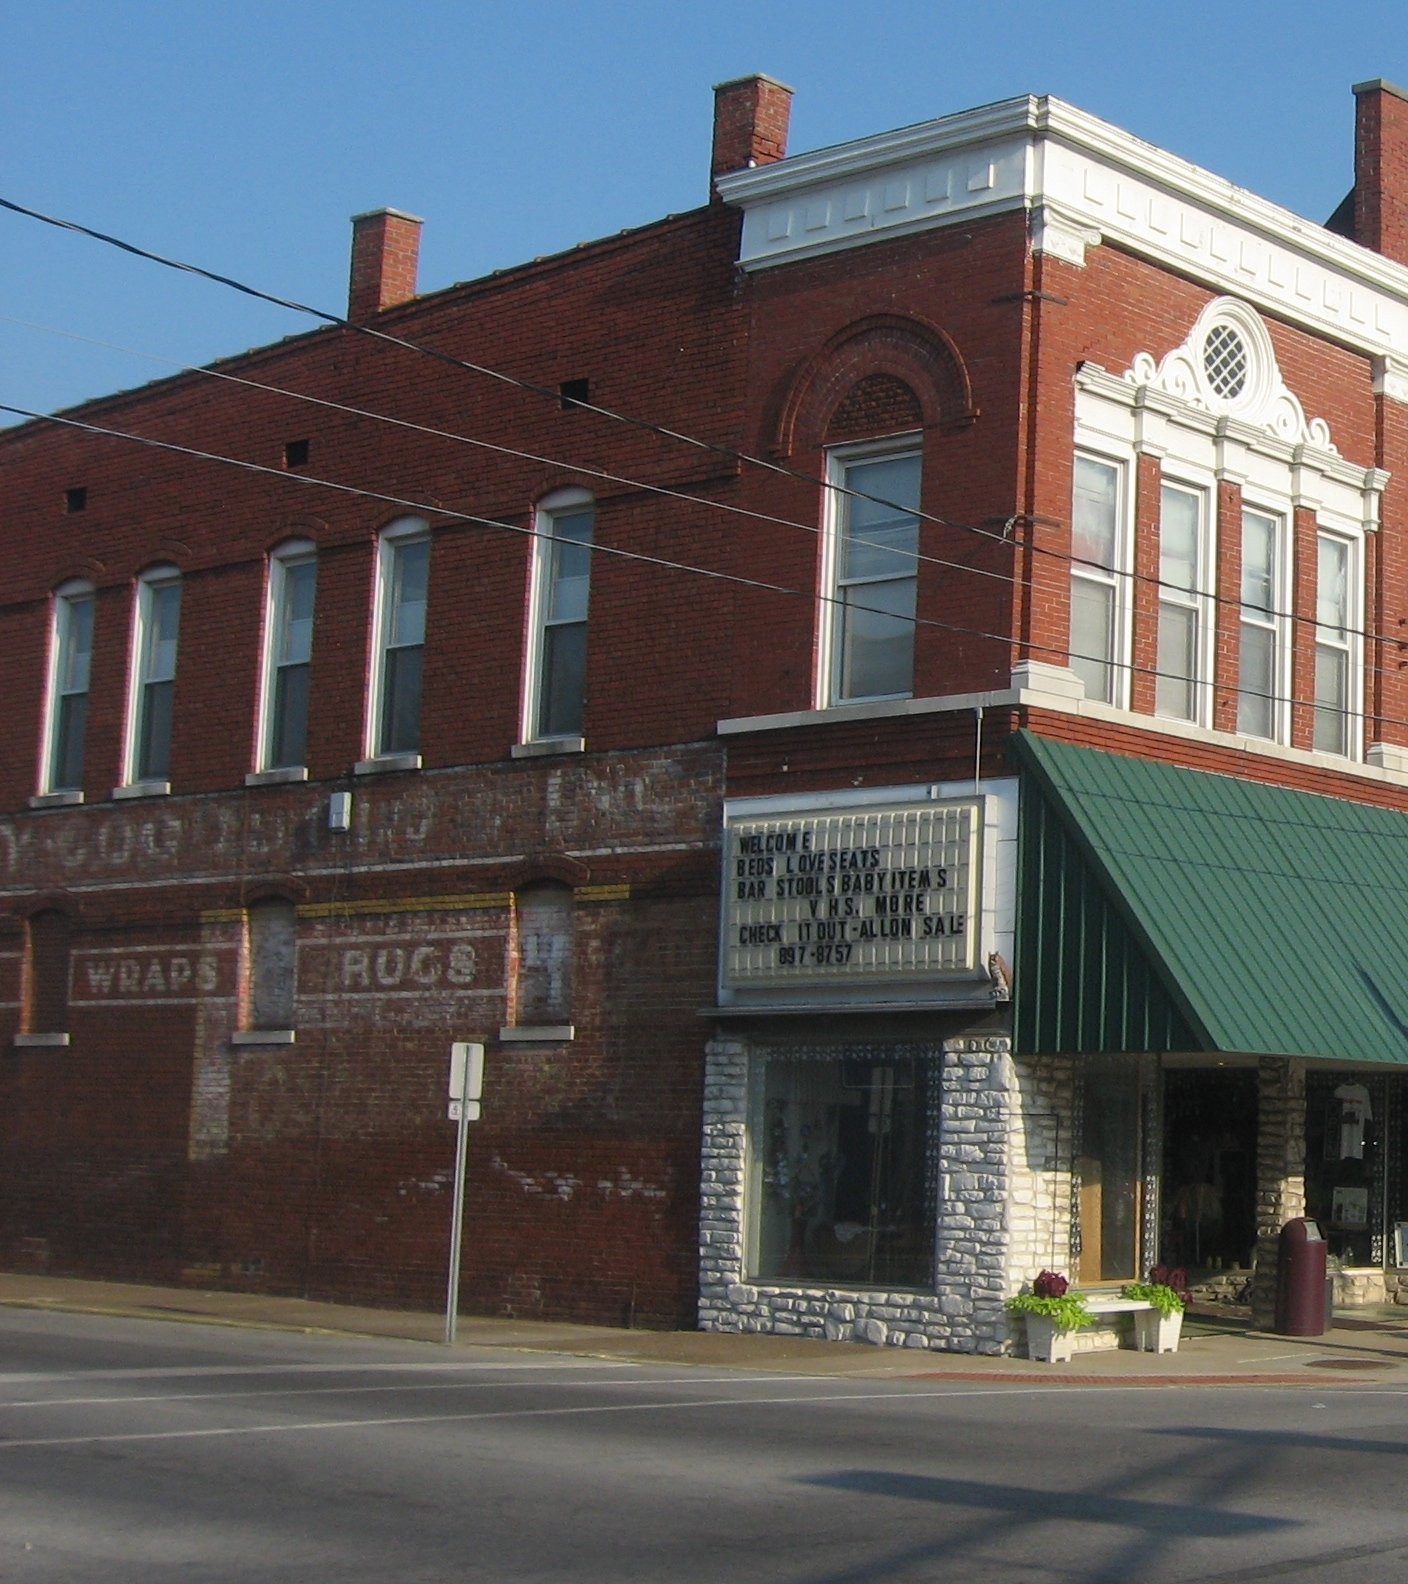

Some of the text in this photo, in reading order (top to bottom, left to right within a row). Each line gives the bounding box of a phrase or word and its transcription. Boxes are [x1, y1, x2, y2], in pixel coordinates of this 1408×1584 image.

[740, 831, 811, 854] WELCOME
[737, 849, 880, 877] BEDS LOVESEATS
[737, 868, 947, 899] BAR STOOLS BABY ITEMS
[875, 893, 924, 914] MORE
[740, 924, 782, 945] CHECK
[798, 922, 811, 941] IT
[923, 914, 964, 935] SALE
[87, 956, 219, 993] WRAPS
[343, 943, 477, 986] RUGS
